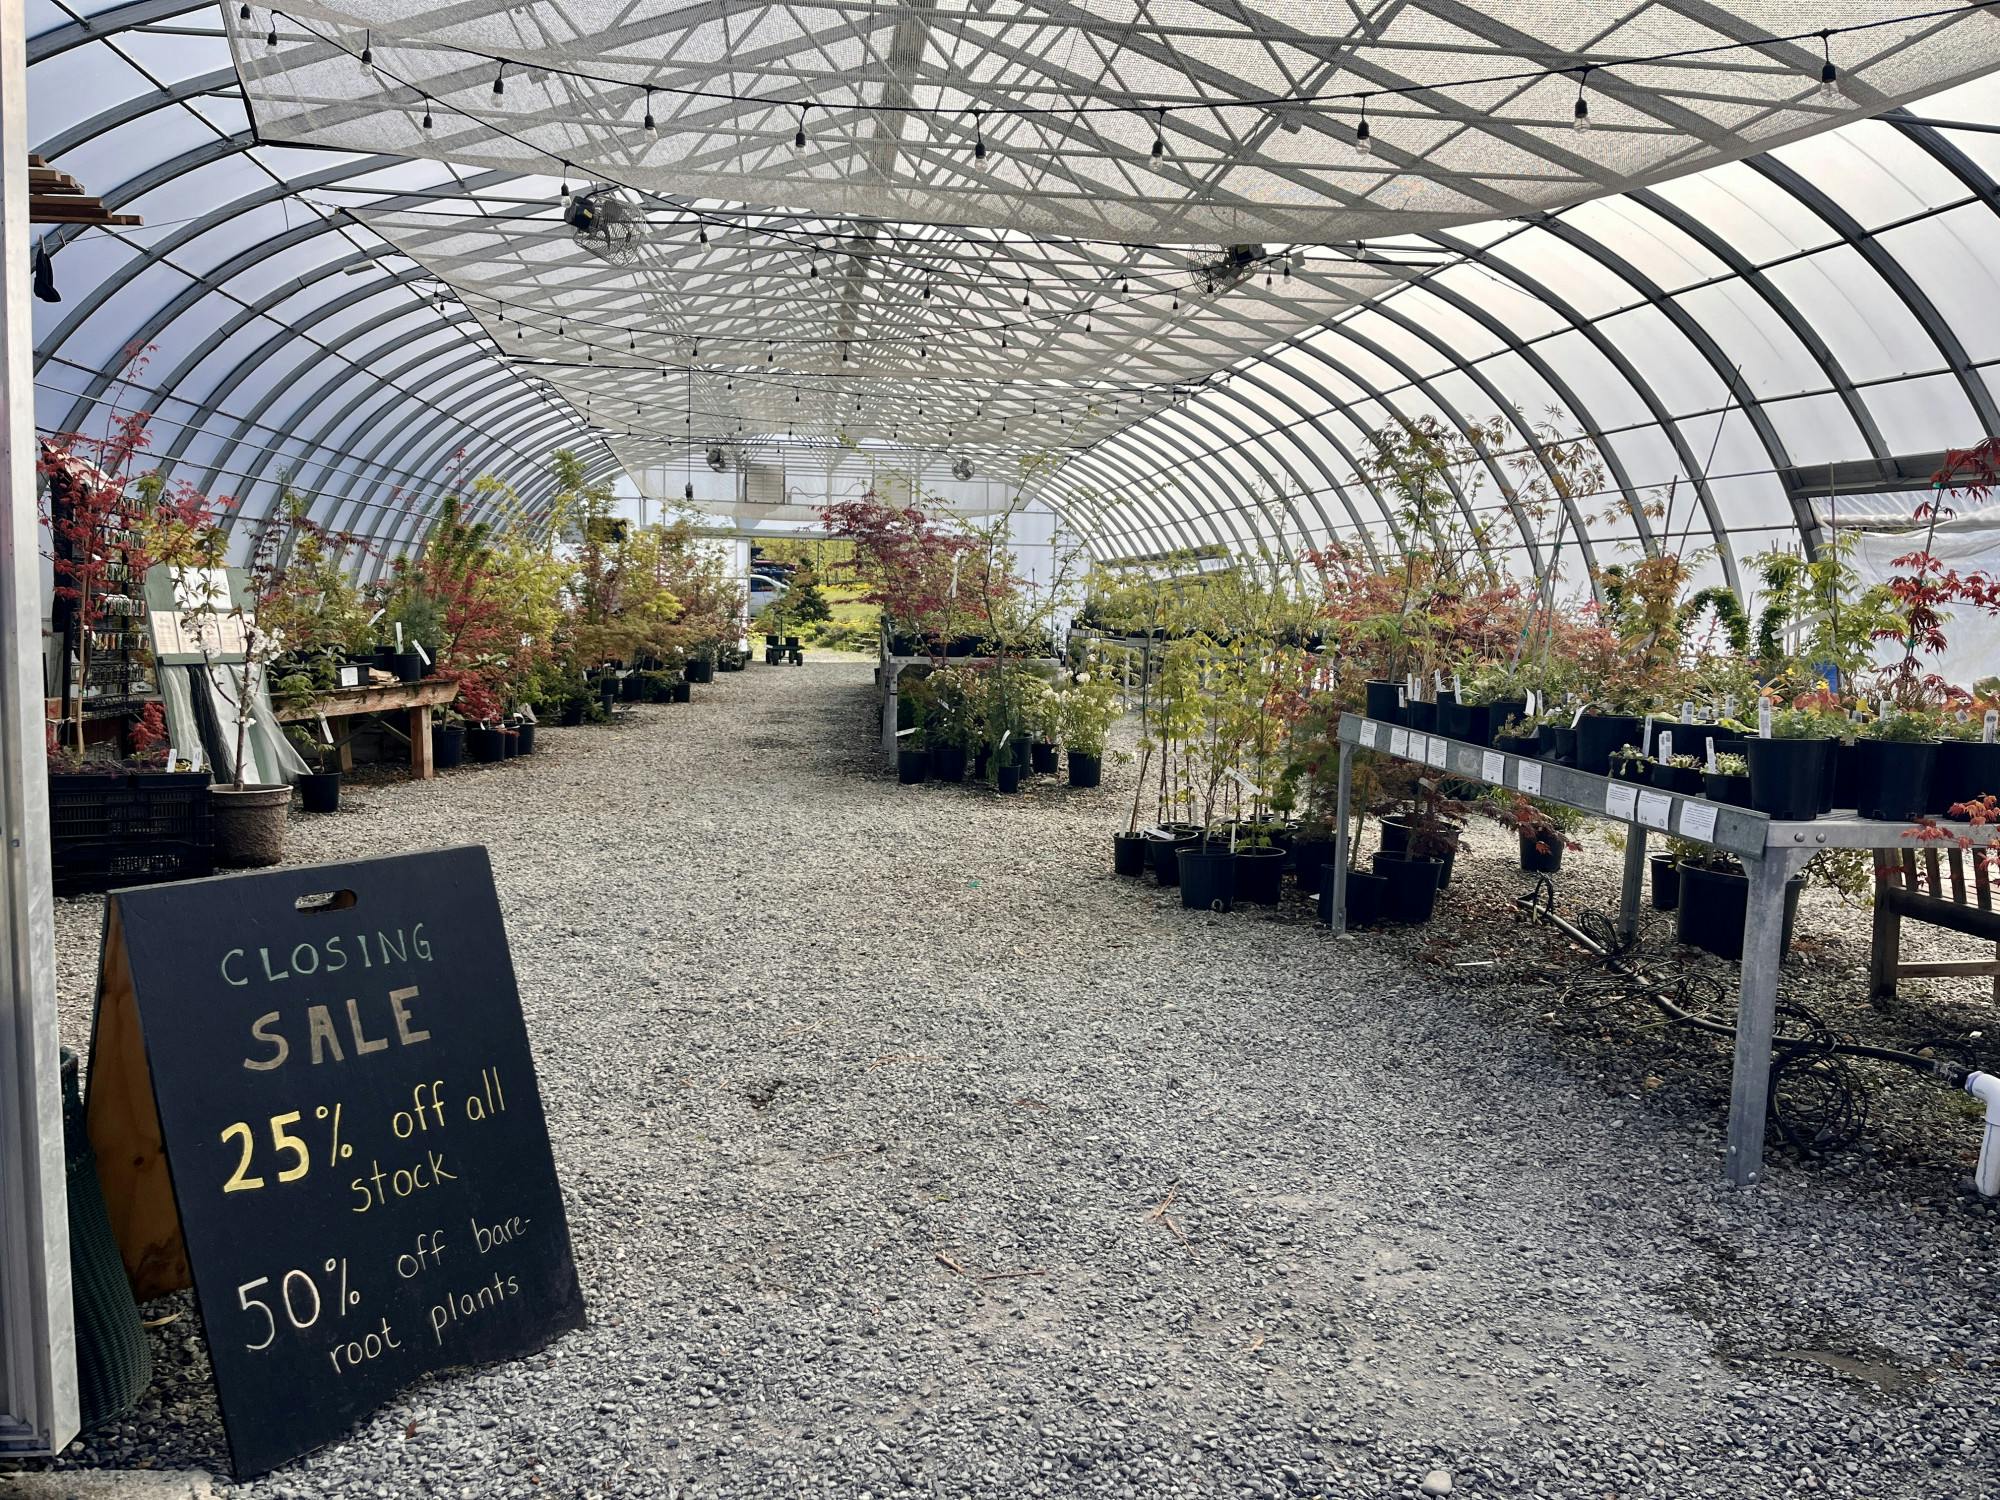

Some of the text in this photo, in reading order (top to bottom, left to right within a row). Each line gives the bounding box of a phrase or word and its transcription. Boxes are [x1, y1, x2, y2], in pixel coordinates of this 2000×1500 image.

[220, 922, 433, 986] CLOSING
[242, 985, 432, 1072] SALE
[219, 1065, 506, 1194] 25% off all
[350, 1149, 459, 1214] stock
[237, 1215, 532, 1351] 50% off bare-
[328, 1272, 521, 1375] root plants
